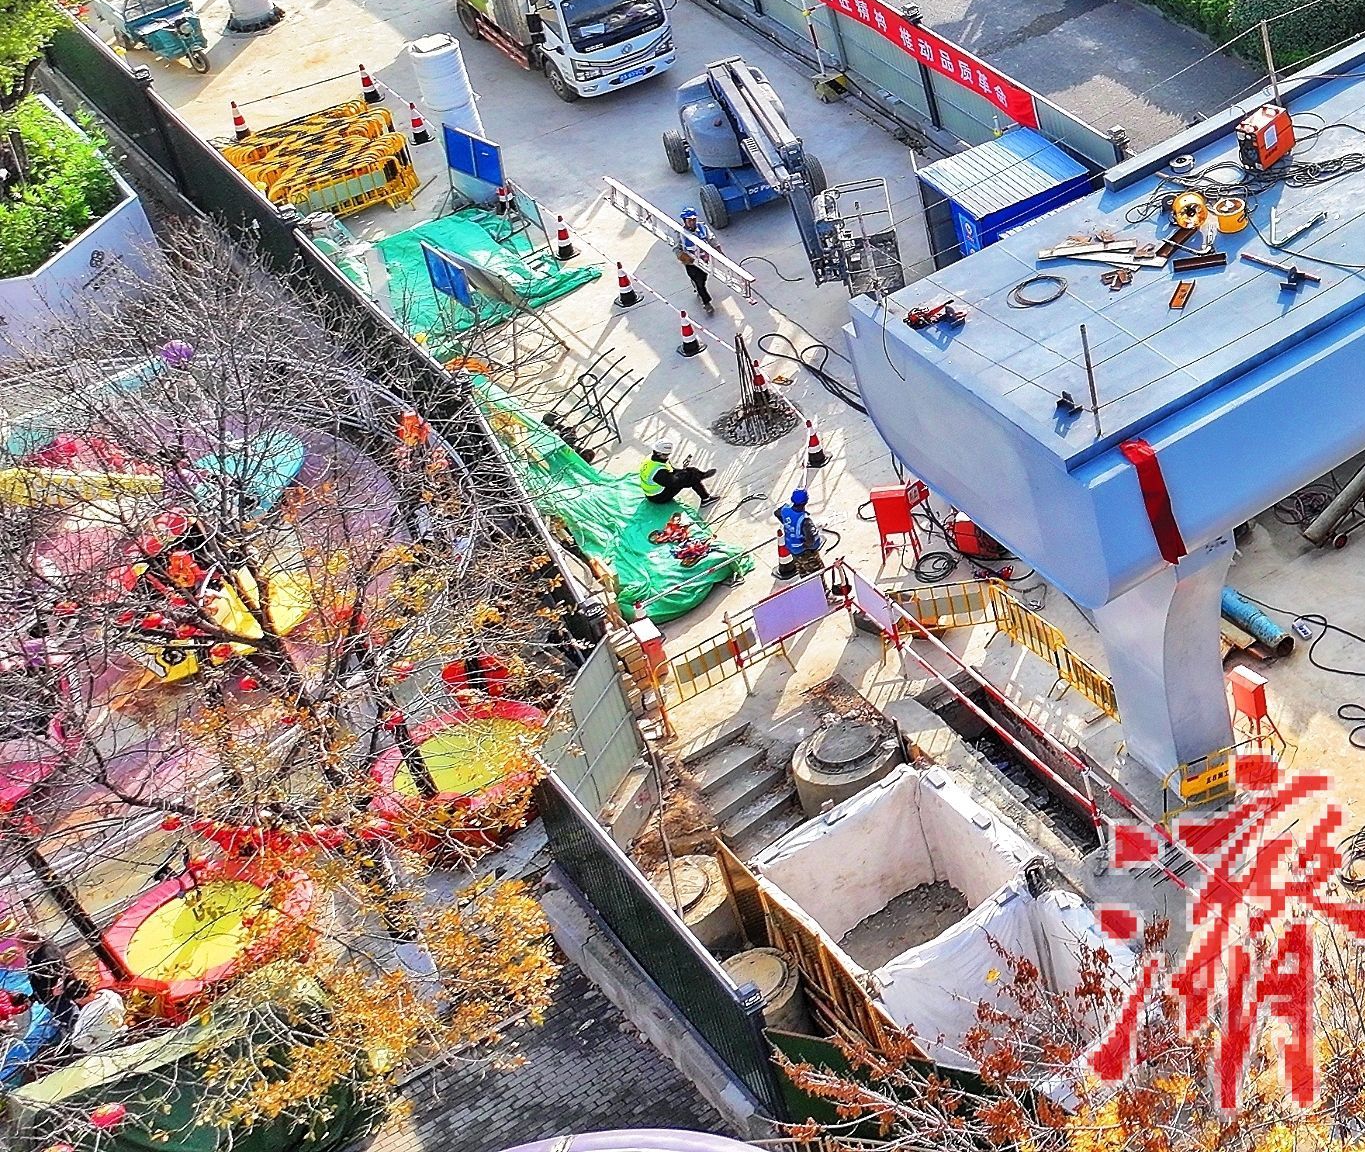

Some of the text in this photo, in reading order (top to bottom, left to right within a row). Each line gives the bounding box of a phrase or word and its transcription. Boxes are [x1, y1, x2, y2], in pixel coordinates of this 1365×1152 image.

[899, 27, 1009, 108] 推动品质革命
